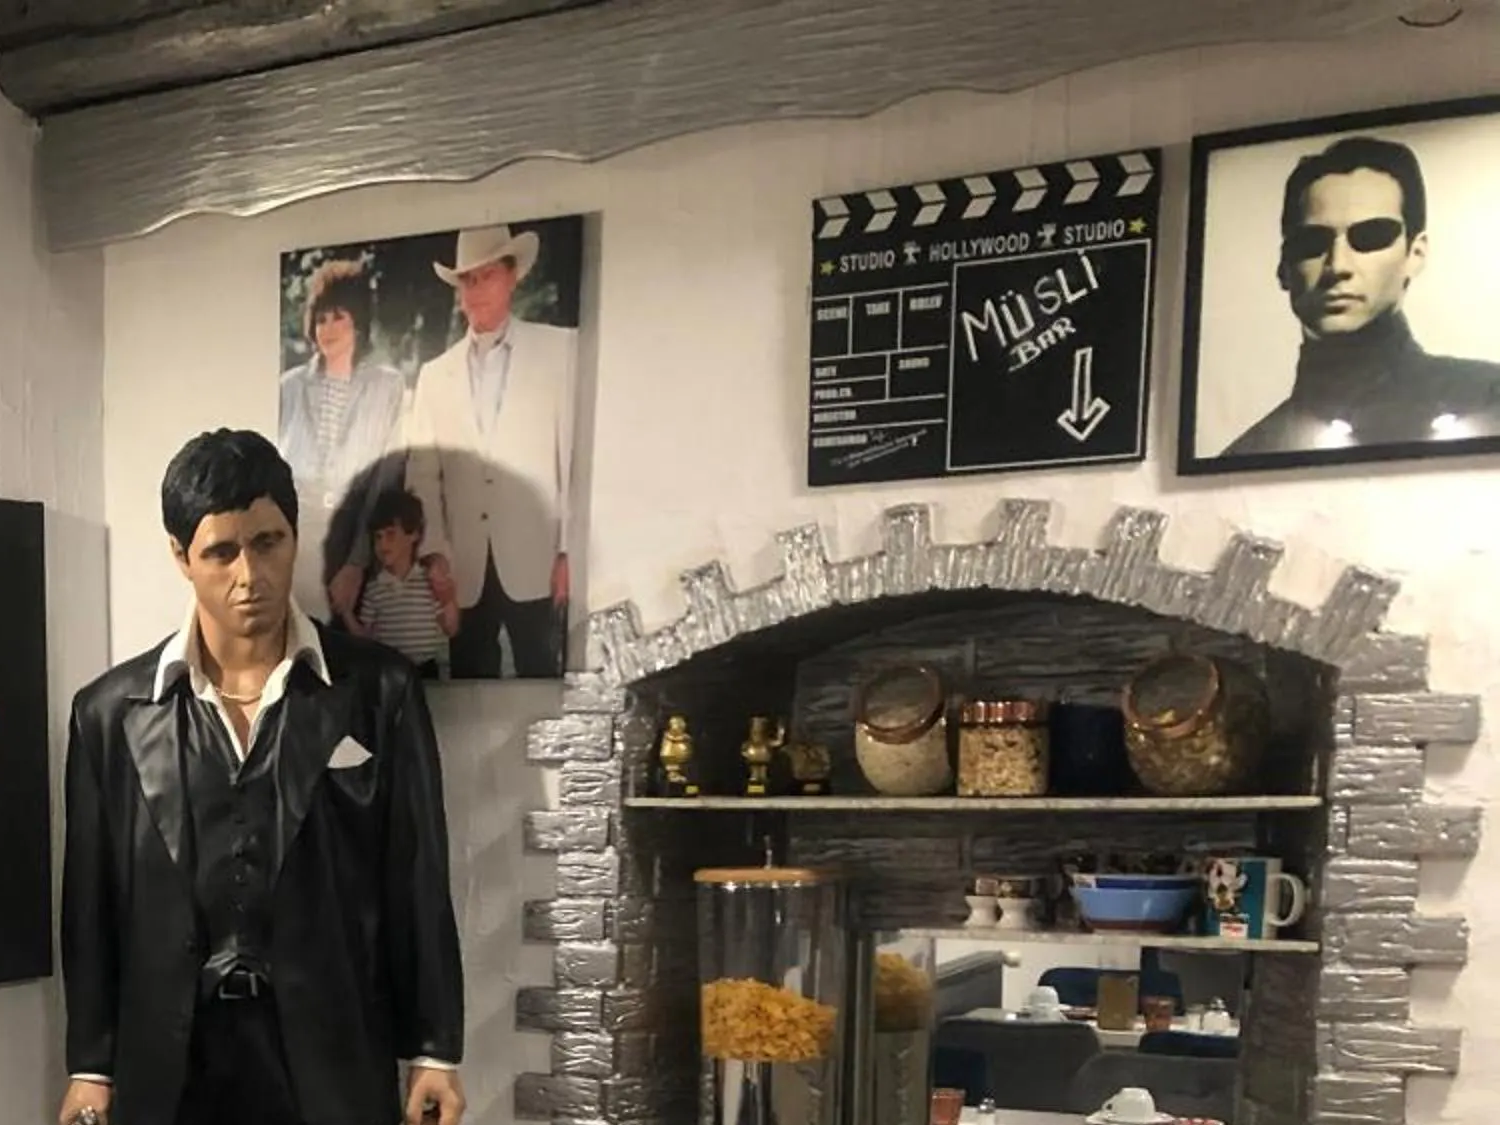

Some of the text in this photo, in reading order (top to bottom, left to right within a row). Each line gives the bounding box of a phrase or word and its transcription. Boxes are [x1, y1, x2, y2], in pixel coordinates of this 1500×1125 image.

[839, 218, 1125, 273] STUDIO HOLLYWOOD STUDIO
